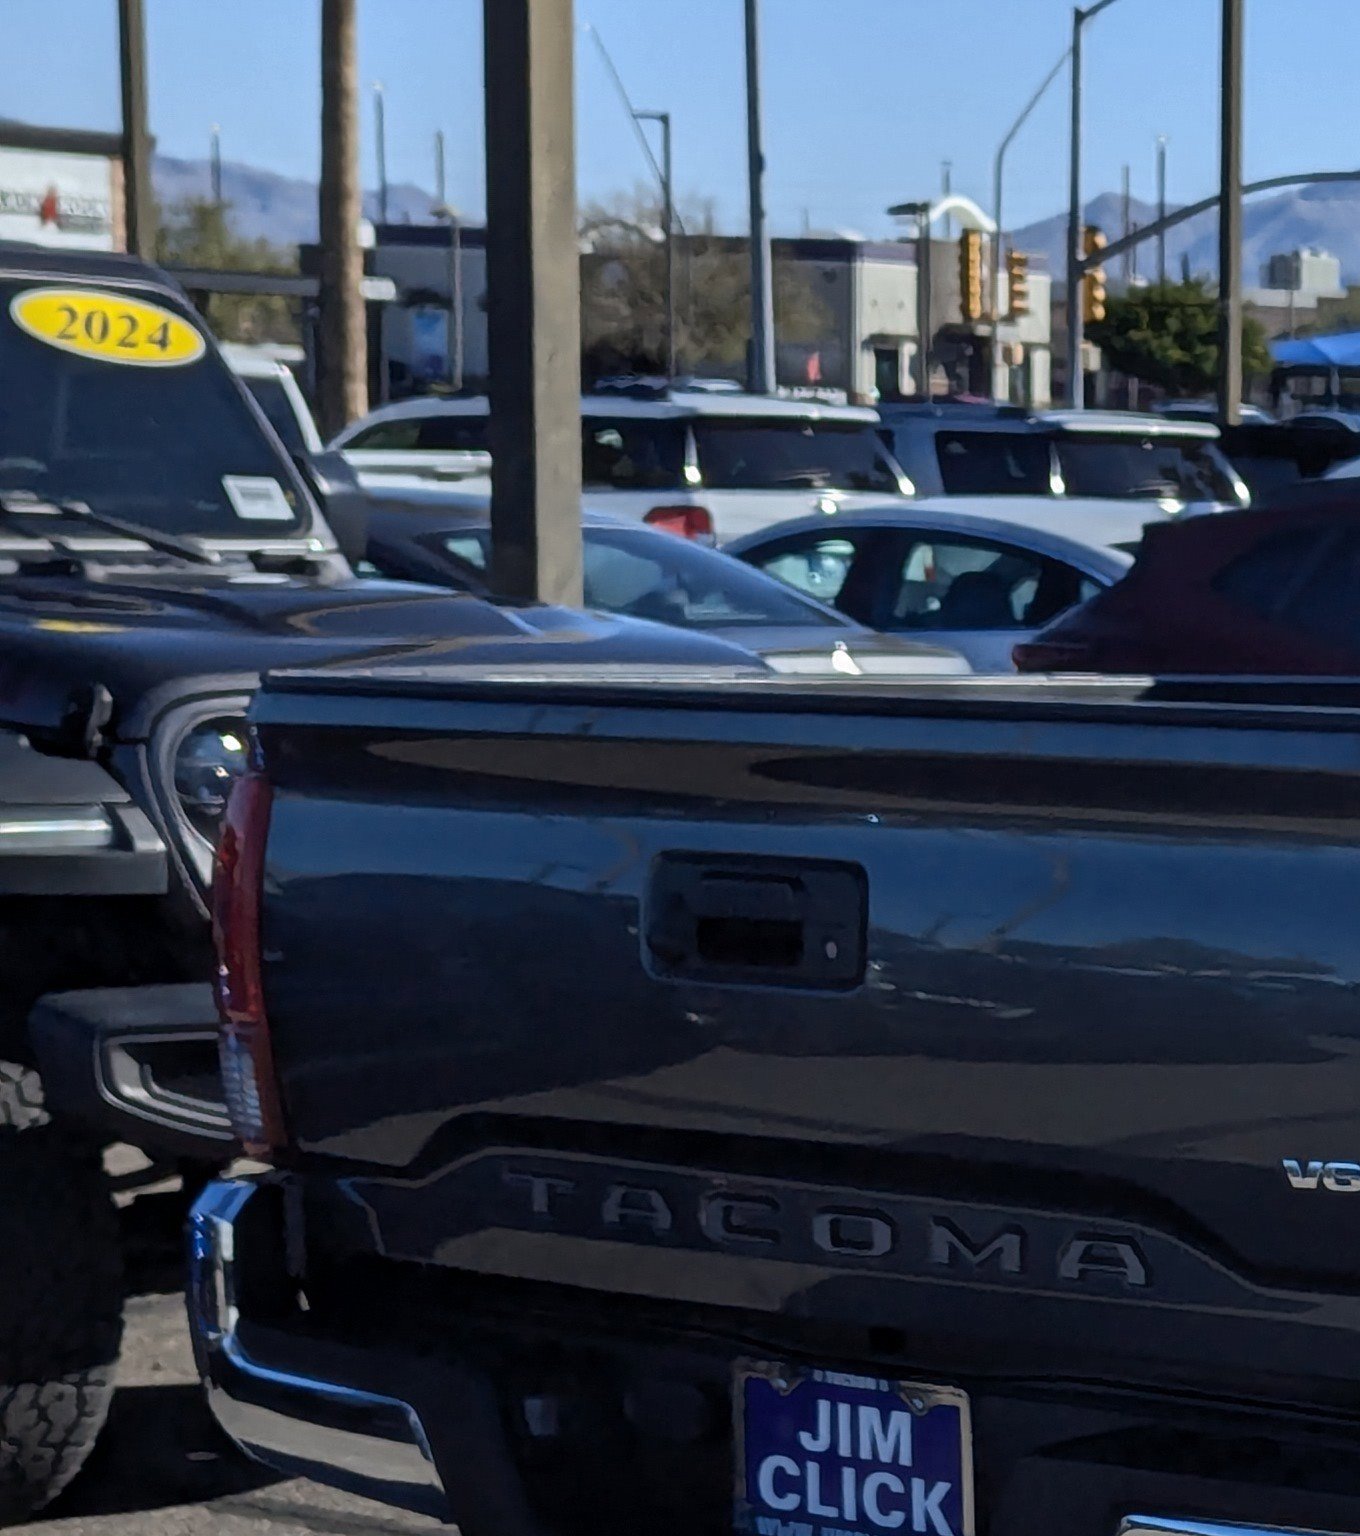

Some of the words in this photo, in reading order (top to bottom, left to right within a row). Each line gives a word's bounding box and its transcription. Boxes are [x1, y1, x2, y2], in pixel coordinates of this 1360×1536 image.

[57, 304, 171, 351] 2024
[502, 1166, 1150, 1287] TACOMA
[798, 1399, 913, 1467] JIM
